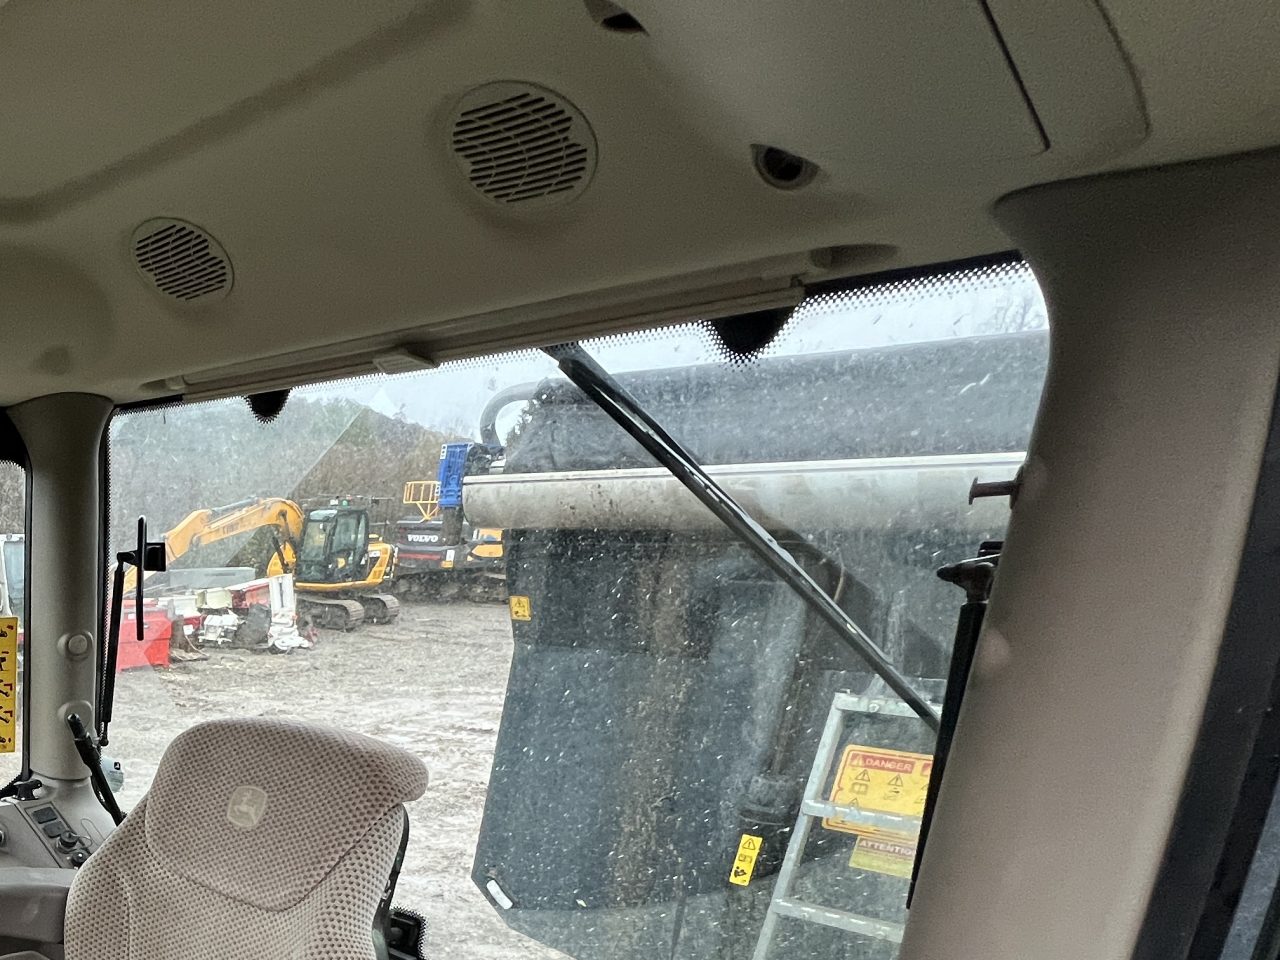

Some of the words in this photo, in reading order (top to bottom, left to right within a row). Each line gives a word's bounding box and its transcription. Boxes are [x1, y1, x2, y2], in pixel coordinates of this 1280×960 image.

[407, 534, 439, 543] VOLVO
[864, 757, 913, 772] DANGER
[860, 841, 917, 856] ATTENTIO
